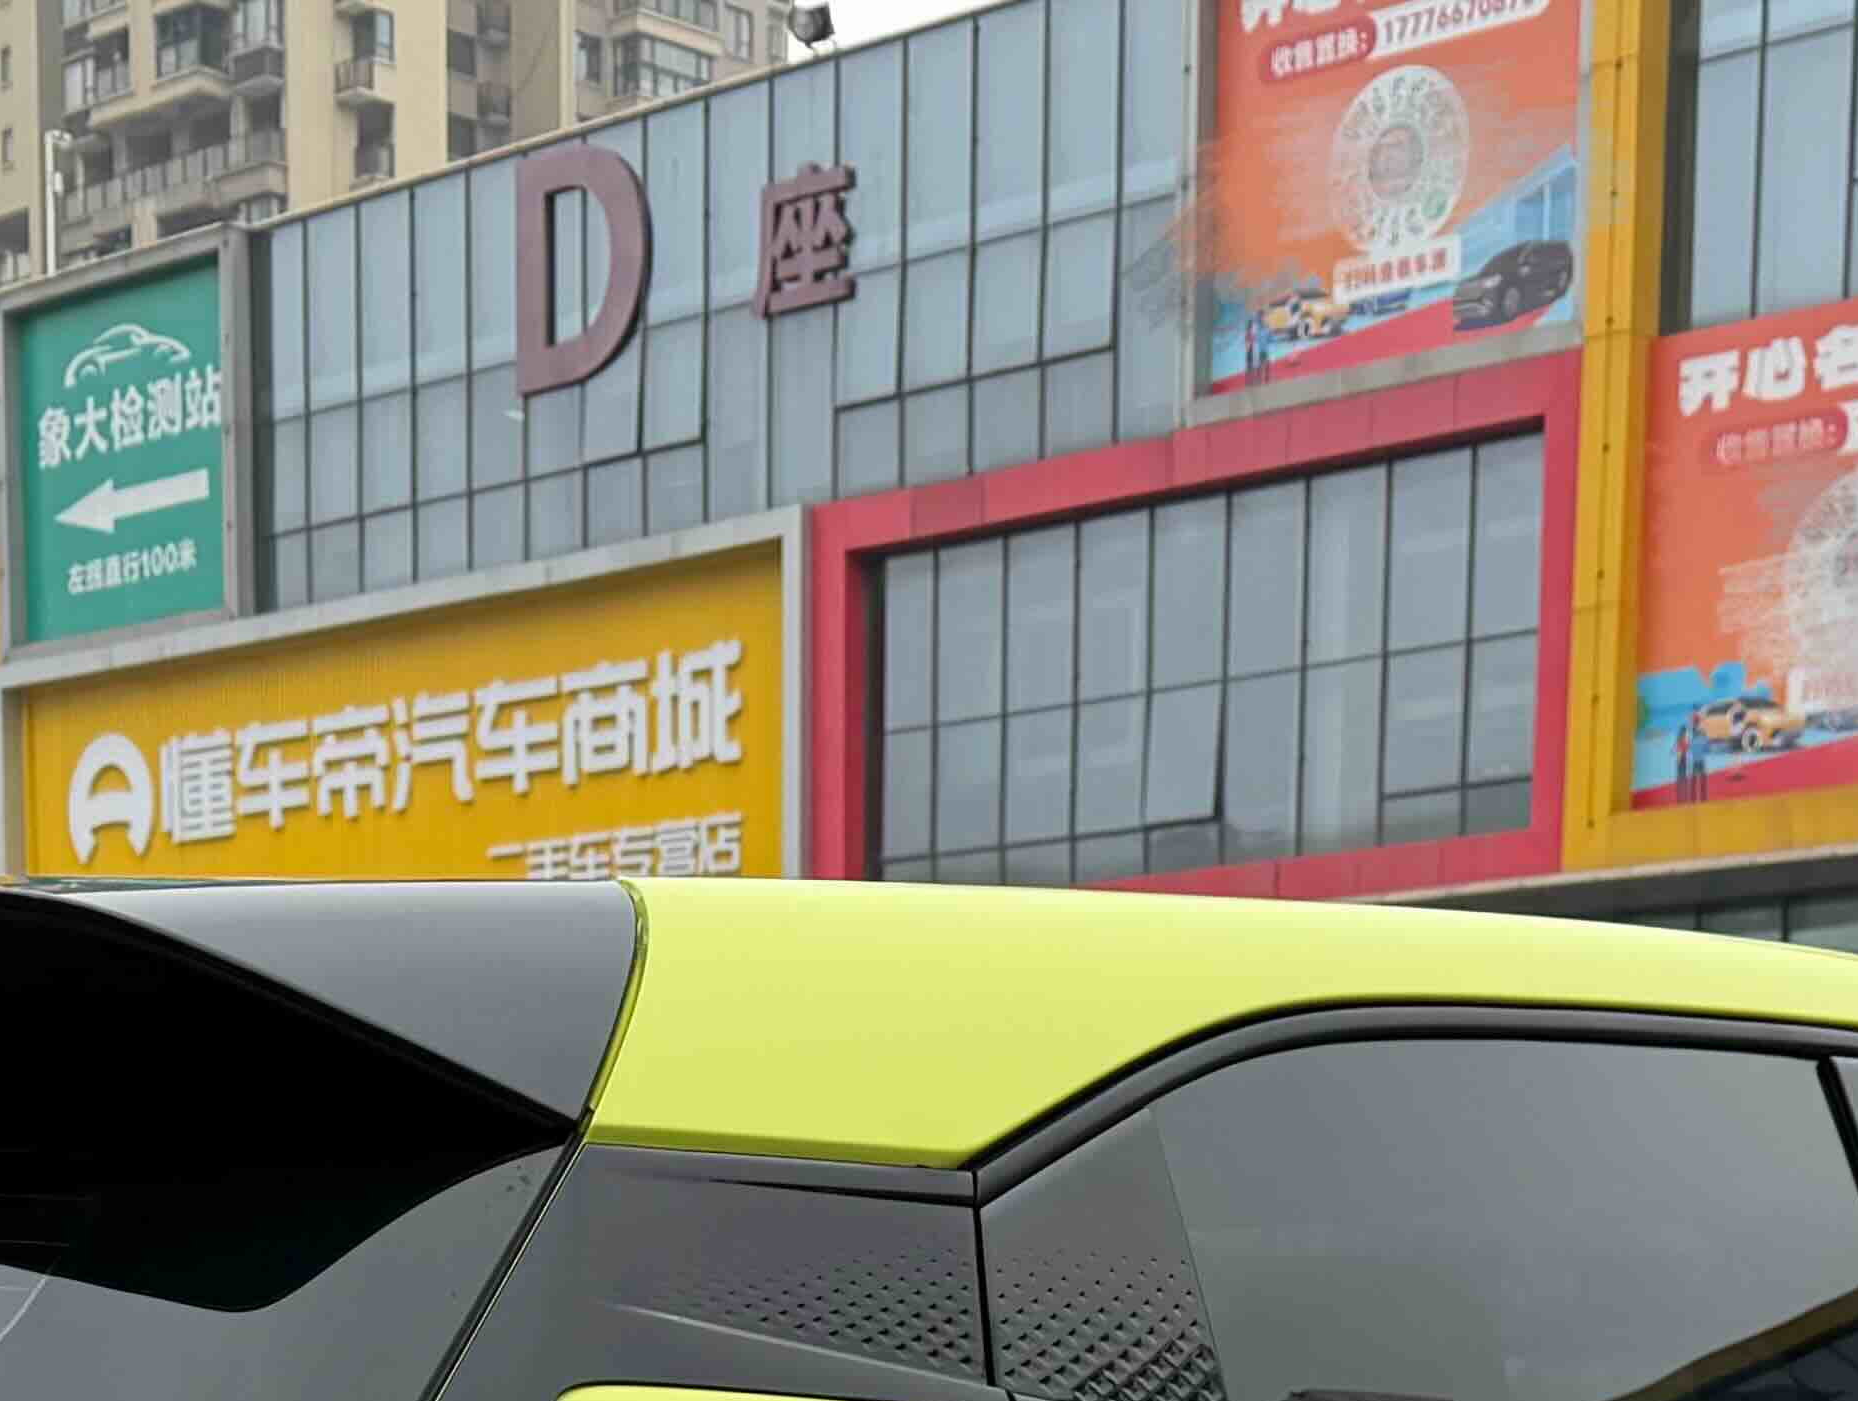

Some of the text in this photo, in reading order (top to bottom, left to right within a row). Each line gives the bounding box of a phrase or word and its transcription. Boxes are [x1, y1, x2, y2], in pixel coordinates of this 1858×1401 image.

[1384, 0, 1534, 44] 177766708
[516, 143, 856, 397] D 座
[37, 363, 222, 470] 象大检测站
[158, 638, 745, 845] 懂车帝汽车商城
